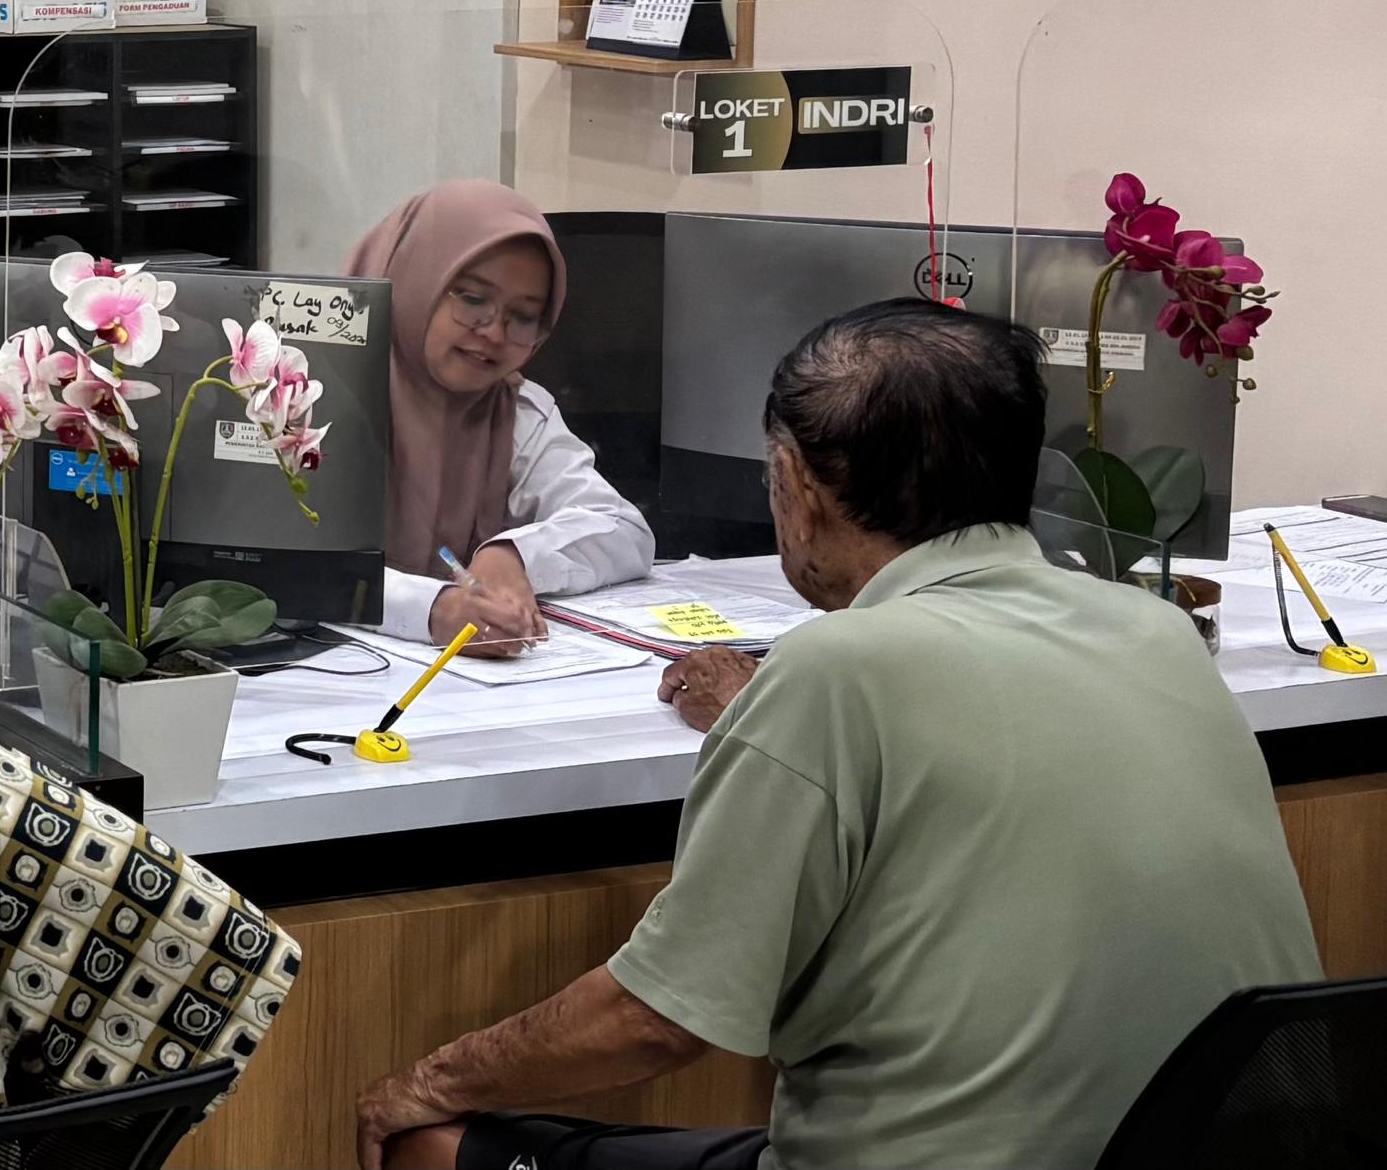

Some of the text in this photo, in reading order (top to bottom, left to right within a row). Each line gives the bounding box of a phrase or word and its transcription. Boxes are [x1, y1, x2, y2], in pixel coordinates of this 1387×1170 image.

[35, 6, 92, 16] KOMPENSASI
[119, 4, 141, 12] FORM
[698, 97, 786, 120] LOKET
[802, 98, 904, 129] INDRI
[721, 120, 753, 159] 1
